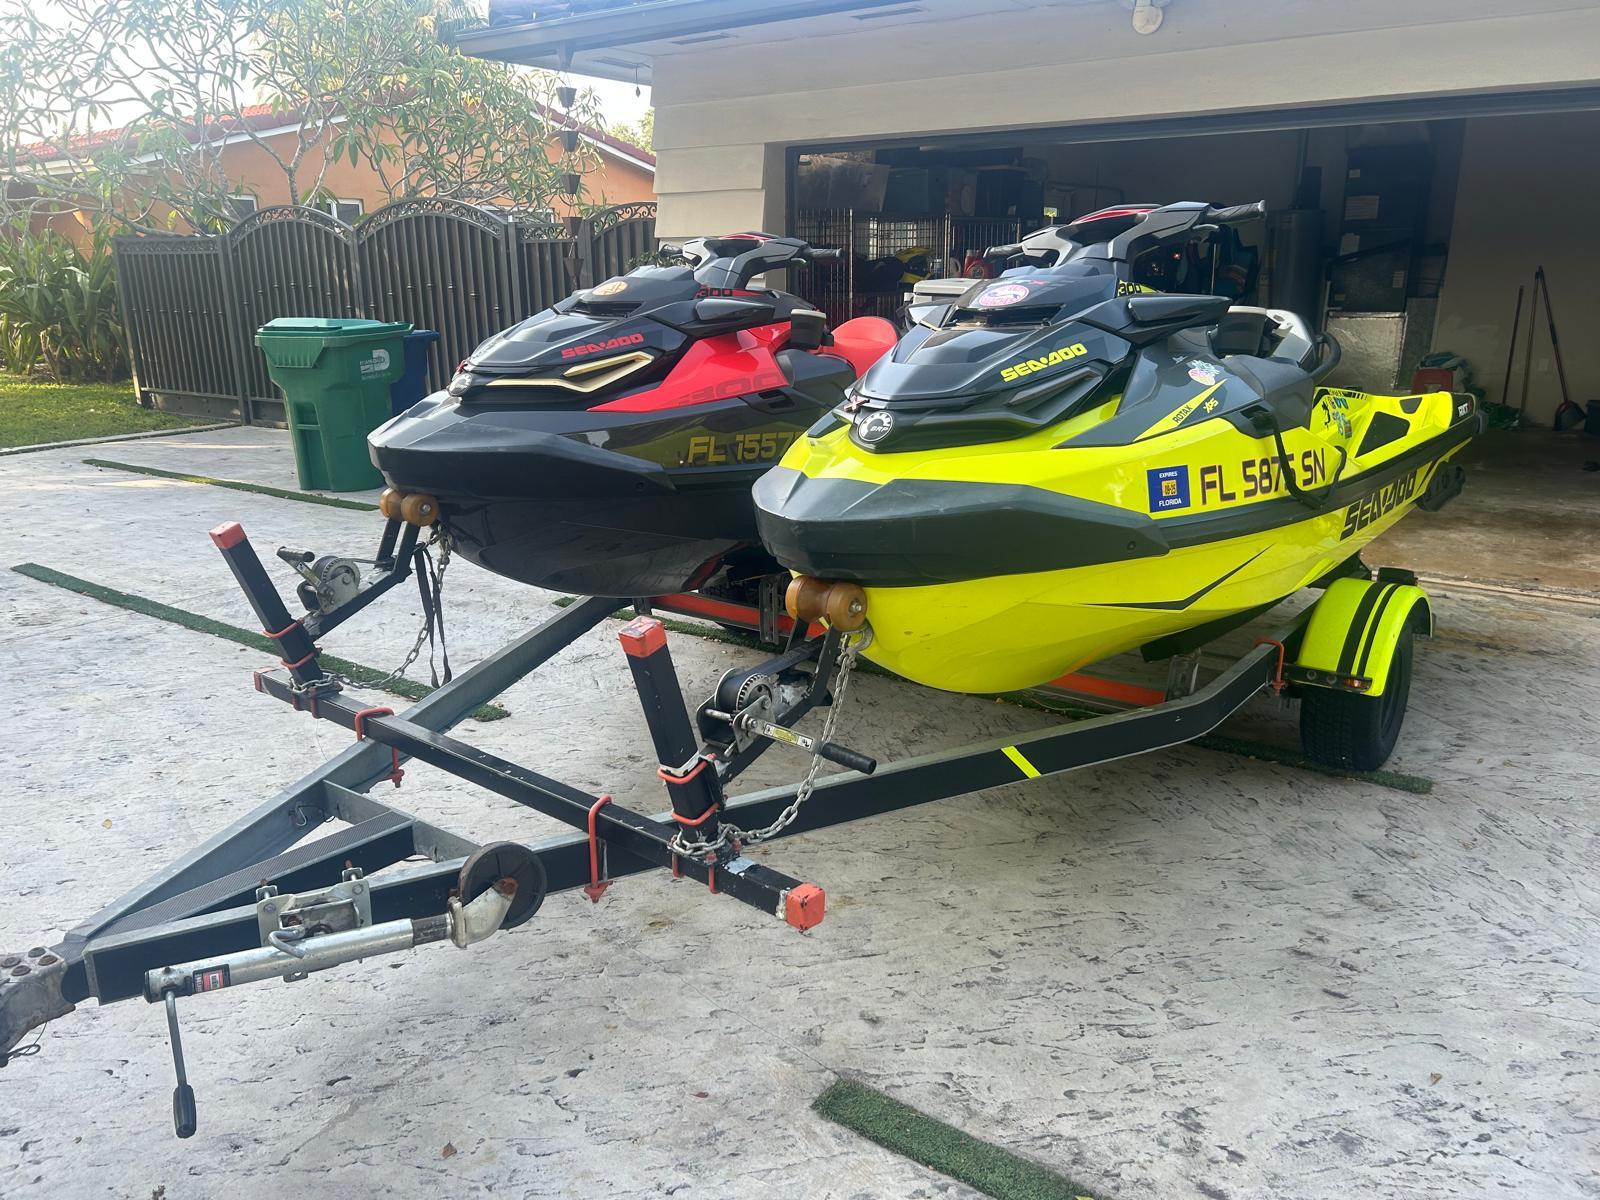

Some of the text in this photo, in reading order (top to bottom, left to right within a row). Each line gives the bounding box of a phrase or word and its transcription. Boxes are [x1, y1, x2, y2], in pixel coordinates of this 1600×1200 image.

[1172, 405, 1193, 423] ROTAX
[687, 431, 801, 464] FL 1557
[1159, 471, 1178, 479] EXPIRES
[1200, 465, 1236, 505] FL
[1301, 448, 1326, 487] SN
[1158, 498, 1182, 507] FLORIDA
